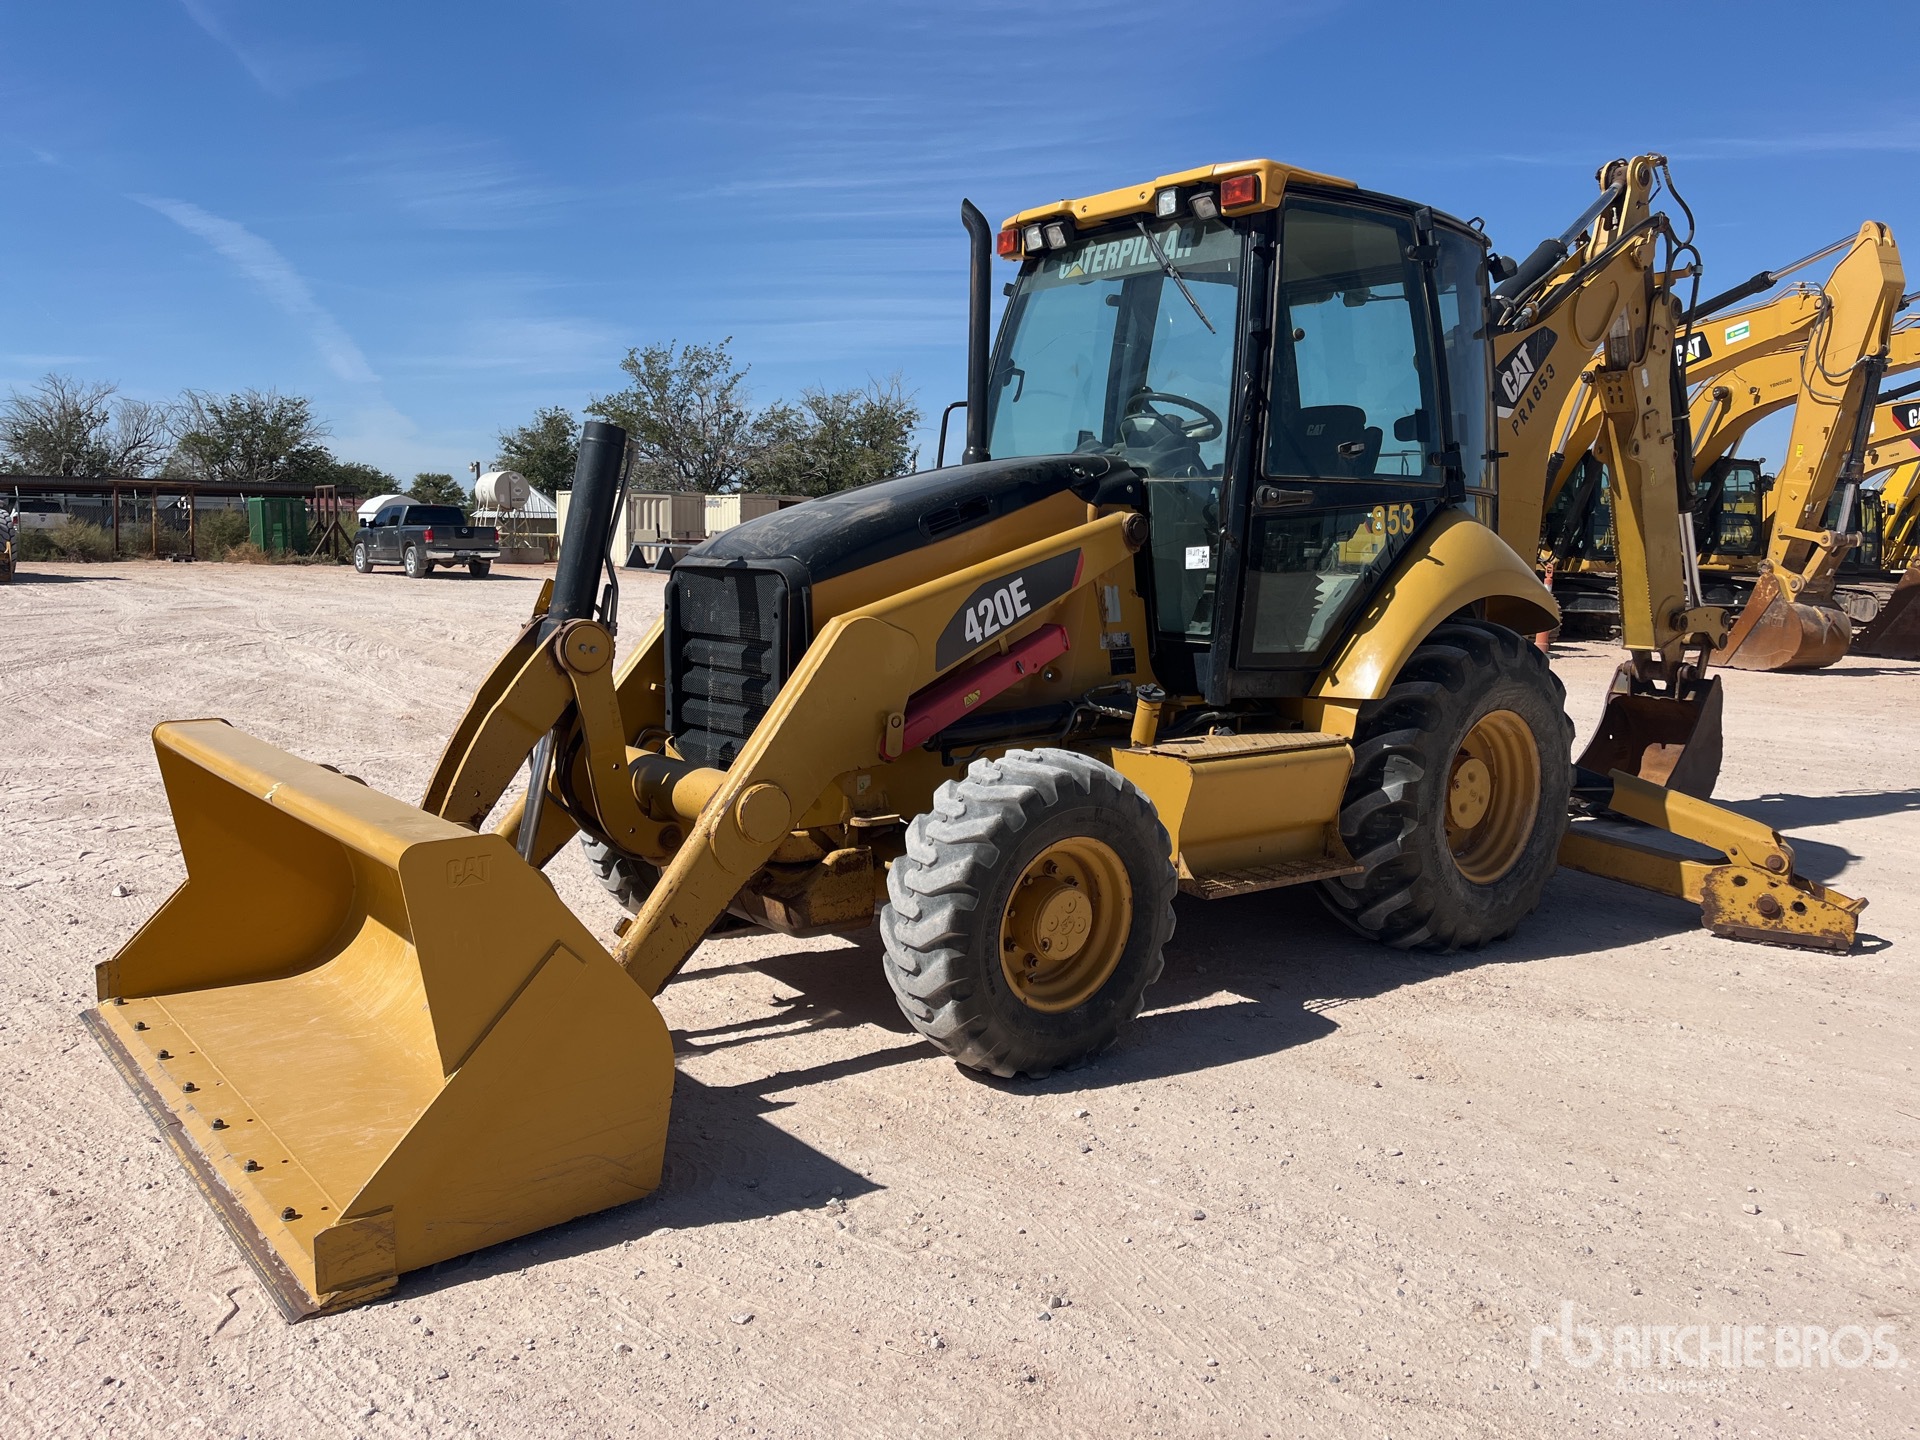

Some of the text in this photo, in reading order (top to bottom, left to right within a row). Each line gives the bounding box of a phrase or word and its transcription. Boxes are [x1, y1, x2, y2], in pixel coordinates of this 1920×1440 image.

[1501, 342, 1536, 403] CAT
[1511, 363, 1556, 437] PRA853
[1306, 423, 1326, 436] CAT
[1371, 503, 1415, 536] 853
[964, 576, 1032, 644] 420E
[446, 853, 493, 889] CAT
